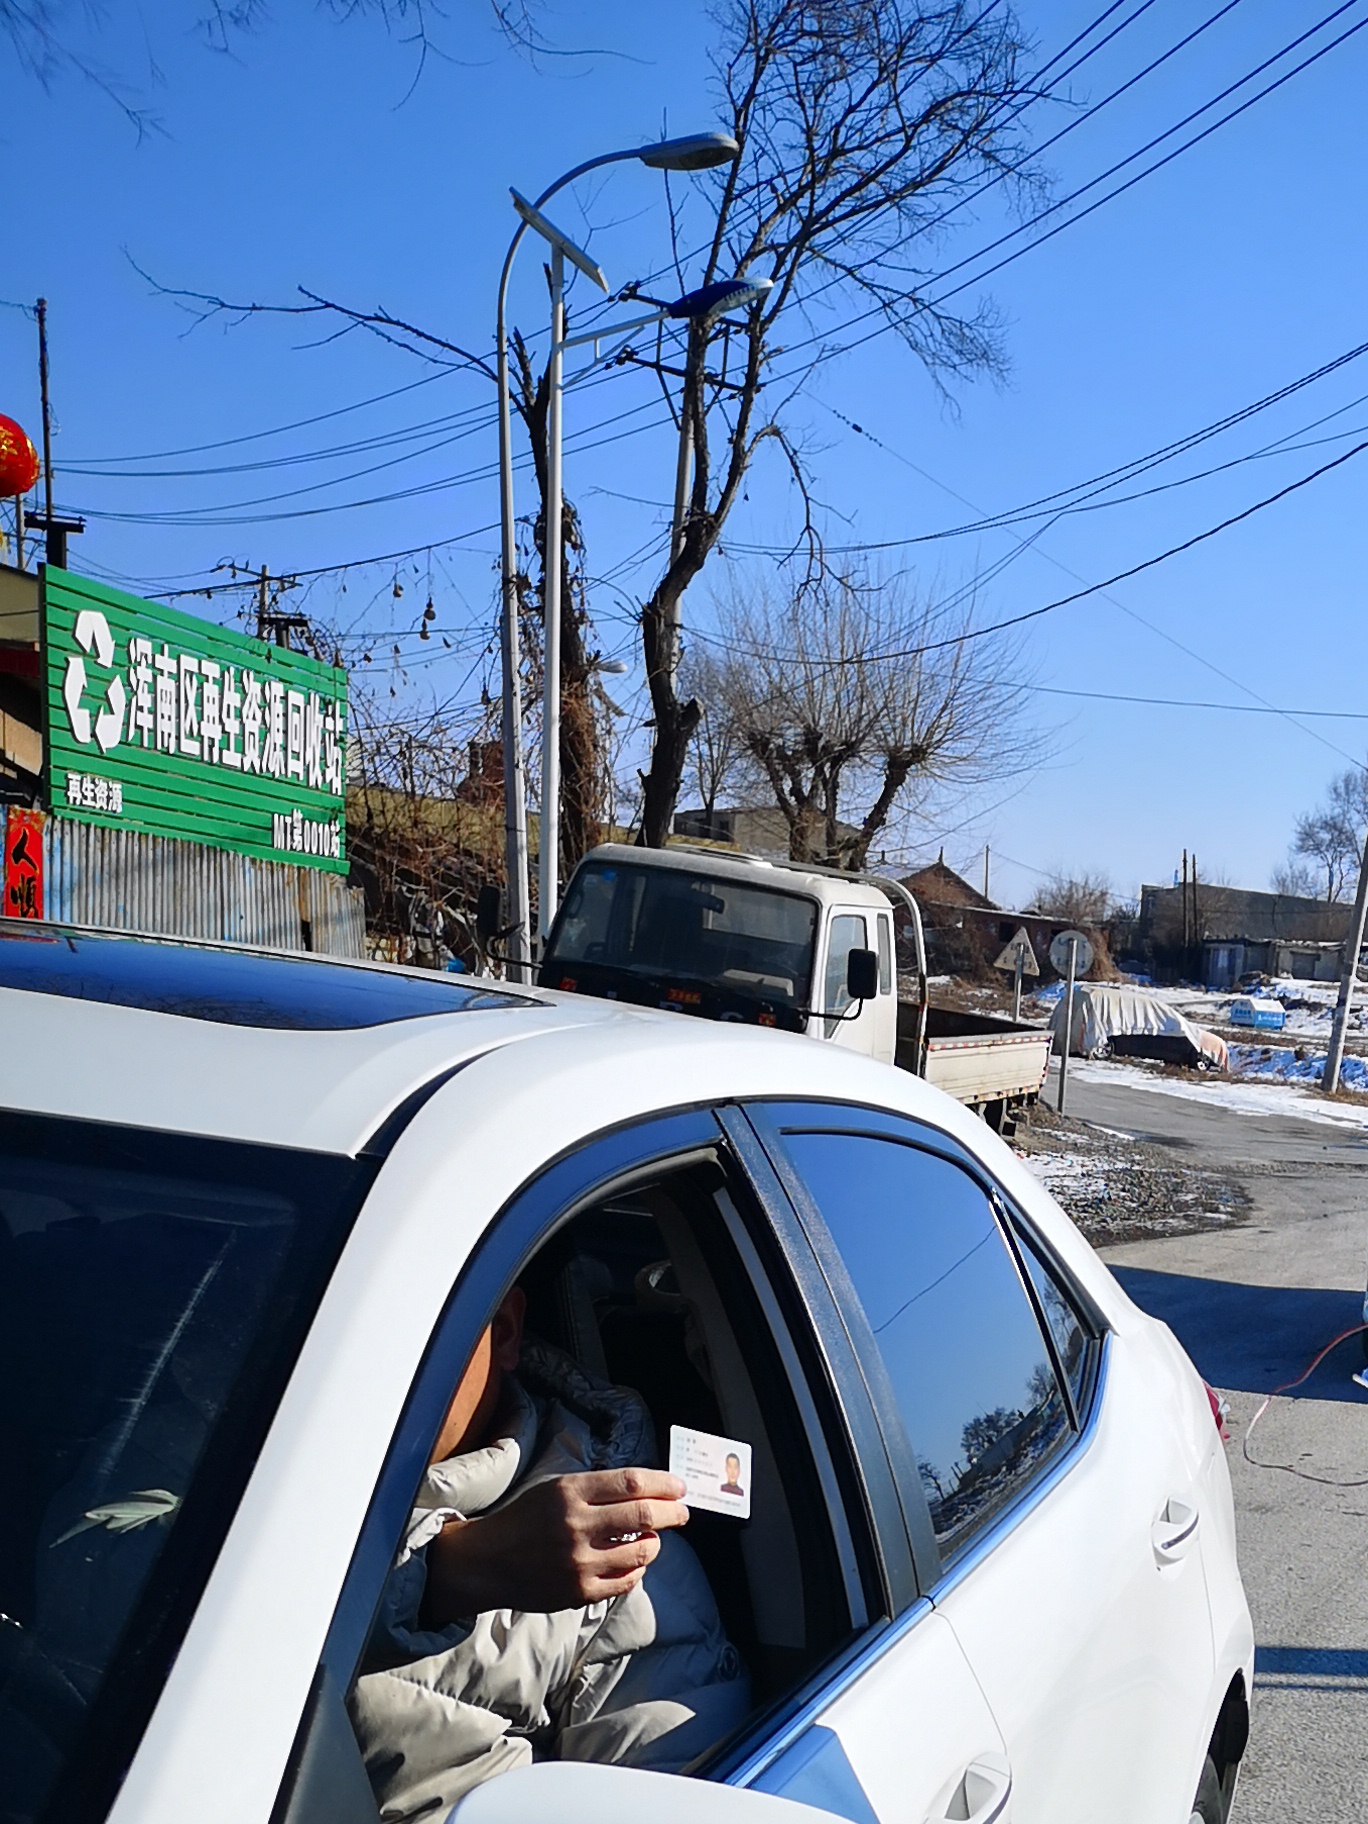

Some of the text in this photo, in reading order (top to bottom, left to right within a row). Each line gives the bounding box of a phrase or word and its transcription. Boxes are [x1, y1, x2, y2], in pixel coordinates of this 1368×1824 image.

[127, 636, 344, 796] 浑南区再生资源回收站
[66, 772, 123, 813] 再生资源
